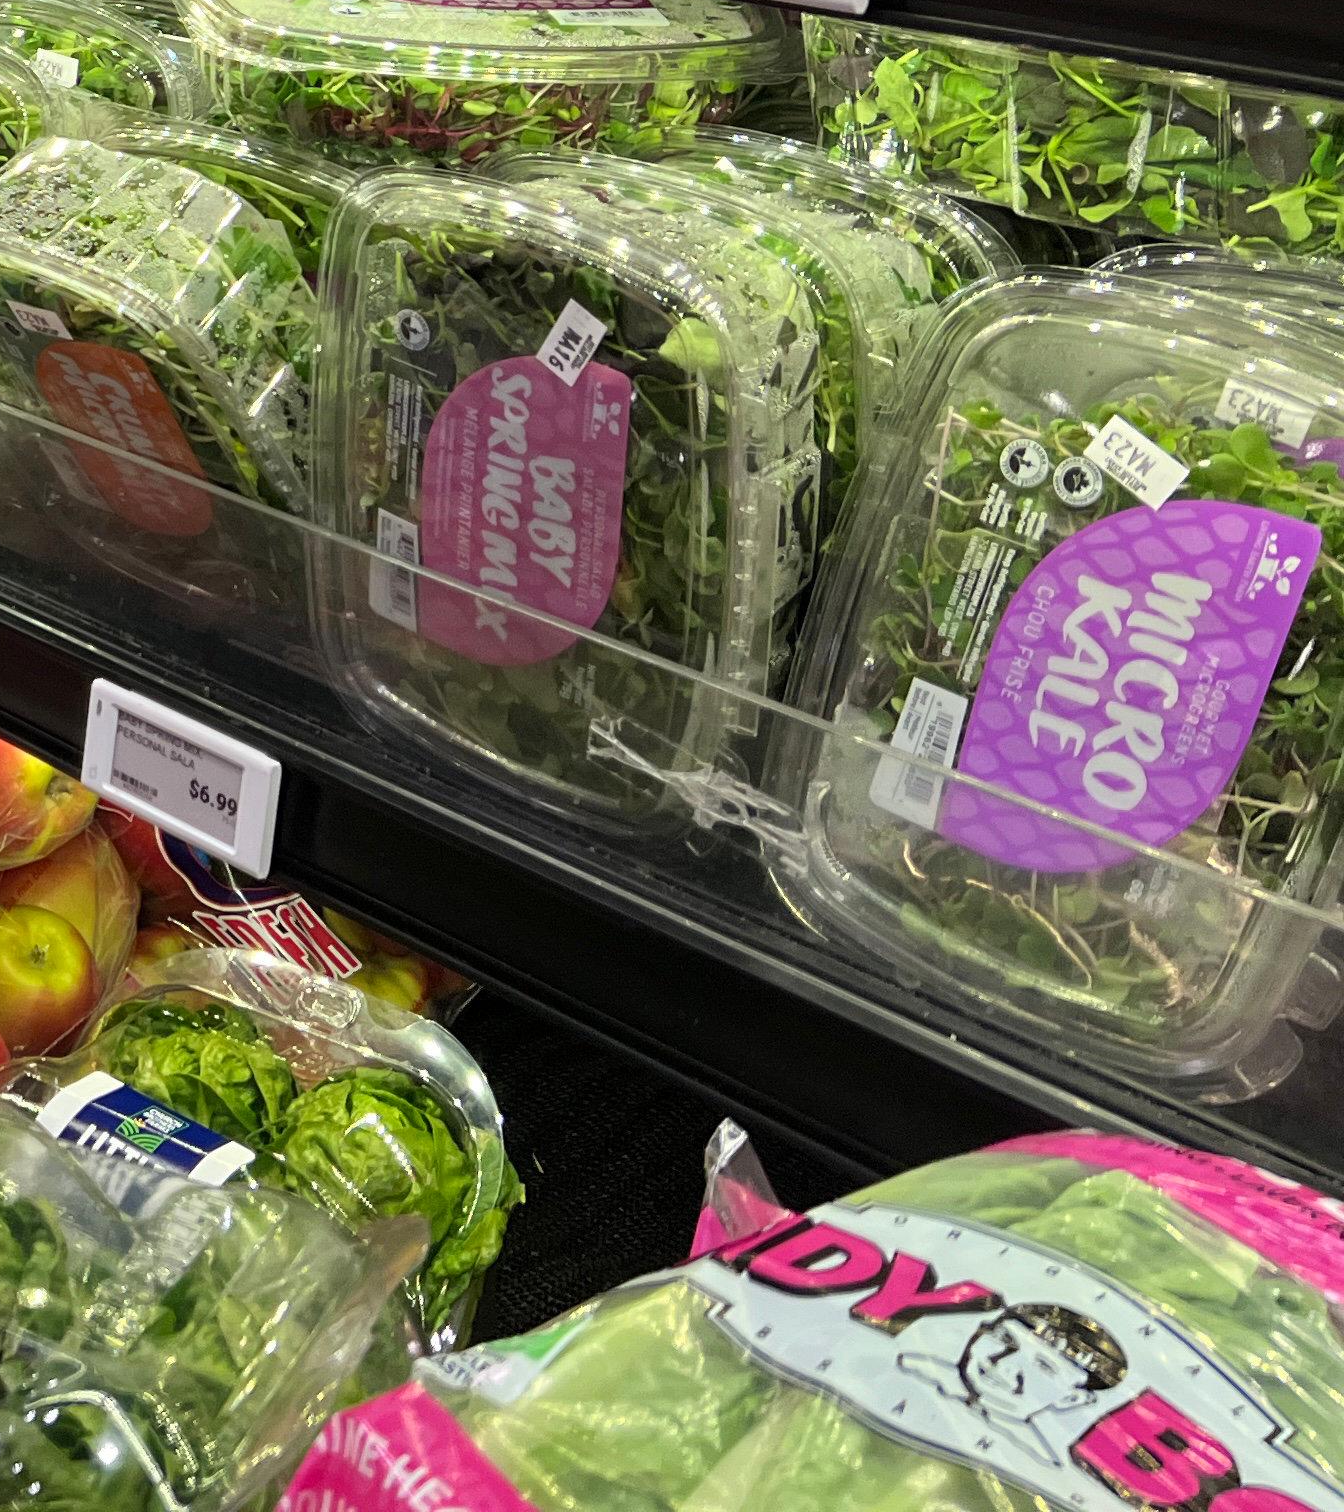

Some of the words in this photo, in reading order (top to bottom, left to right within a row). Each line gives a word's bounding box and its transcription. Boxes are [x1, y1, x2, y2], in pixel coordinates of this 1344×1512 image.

[481, 366, 533, 530] SPRING
[1103, 429, 1159, 479] MA23
[1227, 388, 1285, 426] MA23
[527, 455, 577, 590] BABY
[474, 531, 519, 641] MIX
[1023, 584, 1056, 639] CHOU
[1028, 574, 1132, 759] KALE
[1082, 571, 1212, 811] MICRO
[117, 725, 167, 759] PERSONAL
[170, 750, 196, 769] SALA
[1192, 678, 1231, 759] GOURMET
[189, 778, 237, 817] $6.99
[757, 1325, 1085, 1504] BRAND
